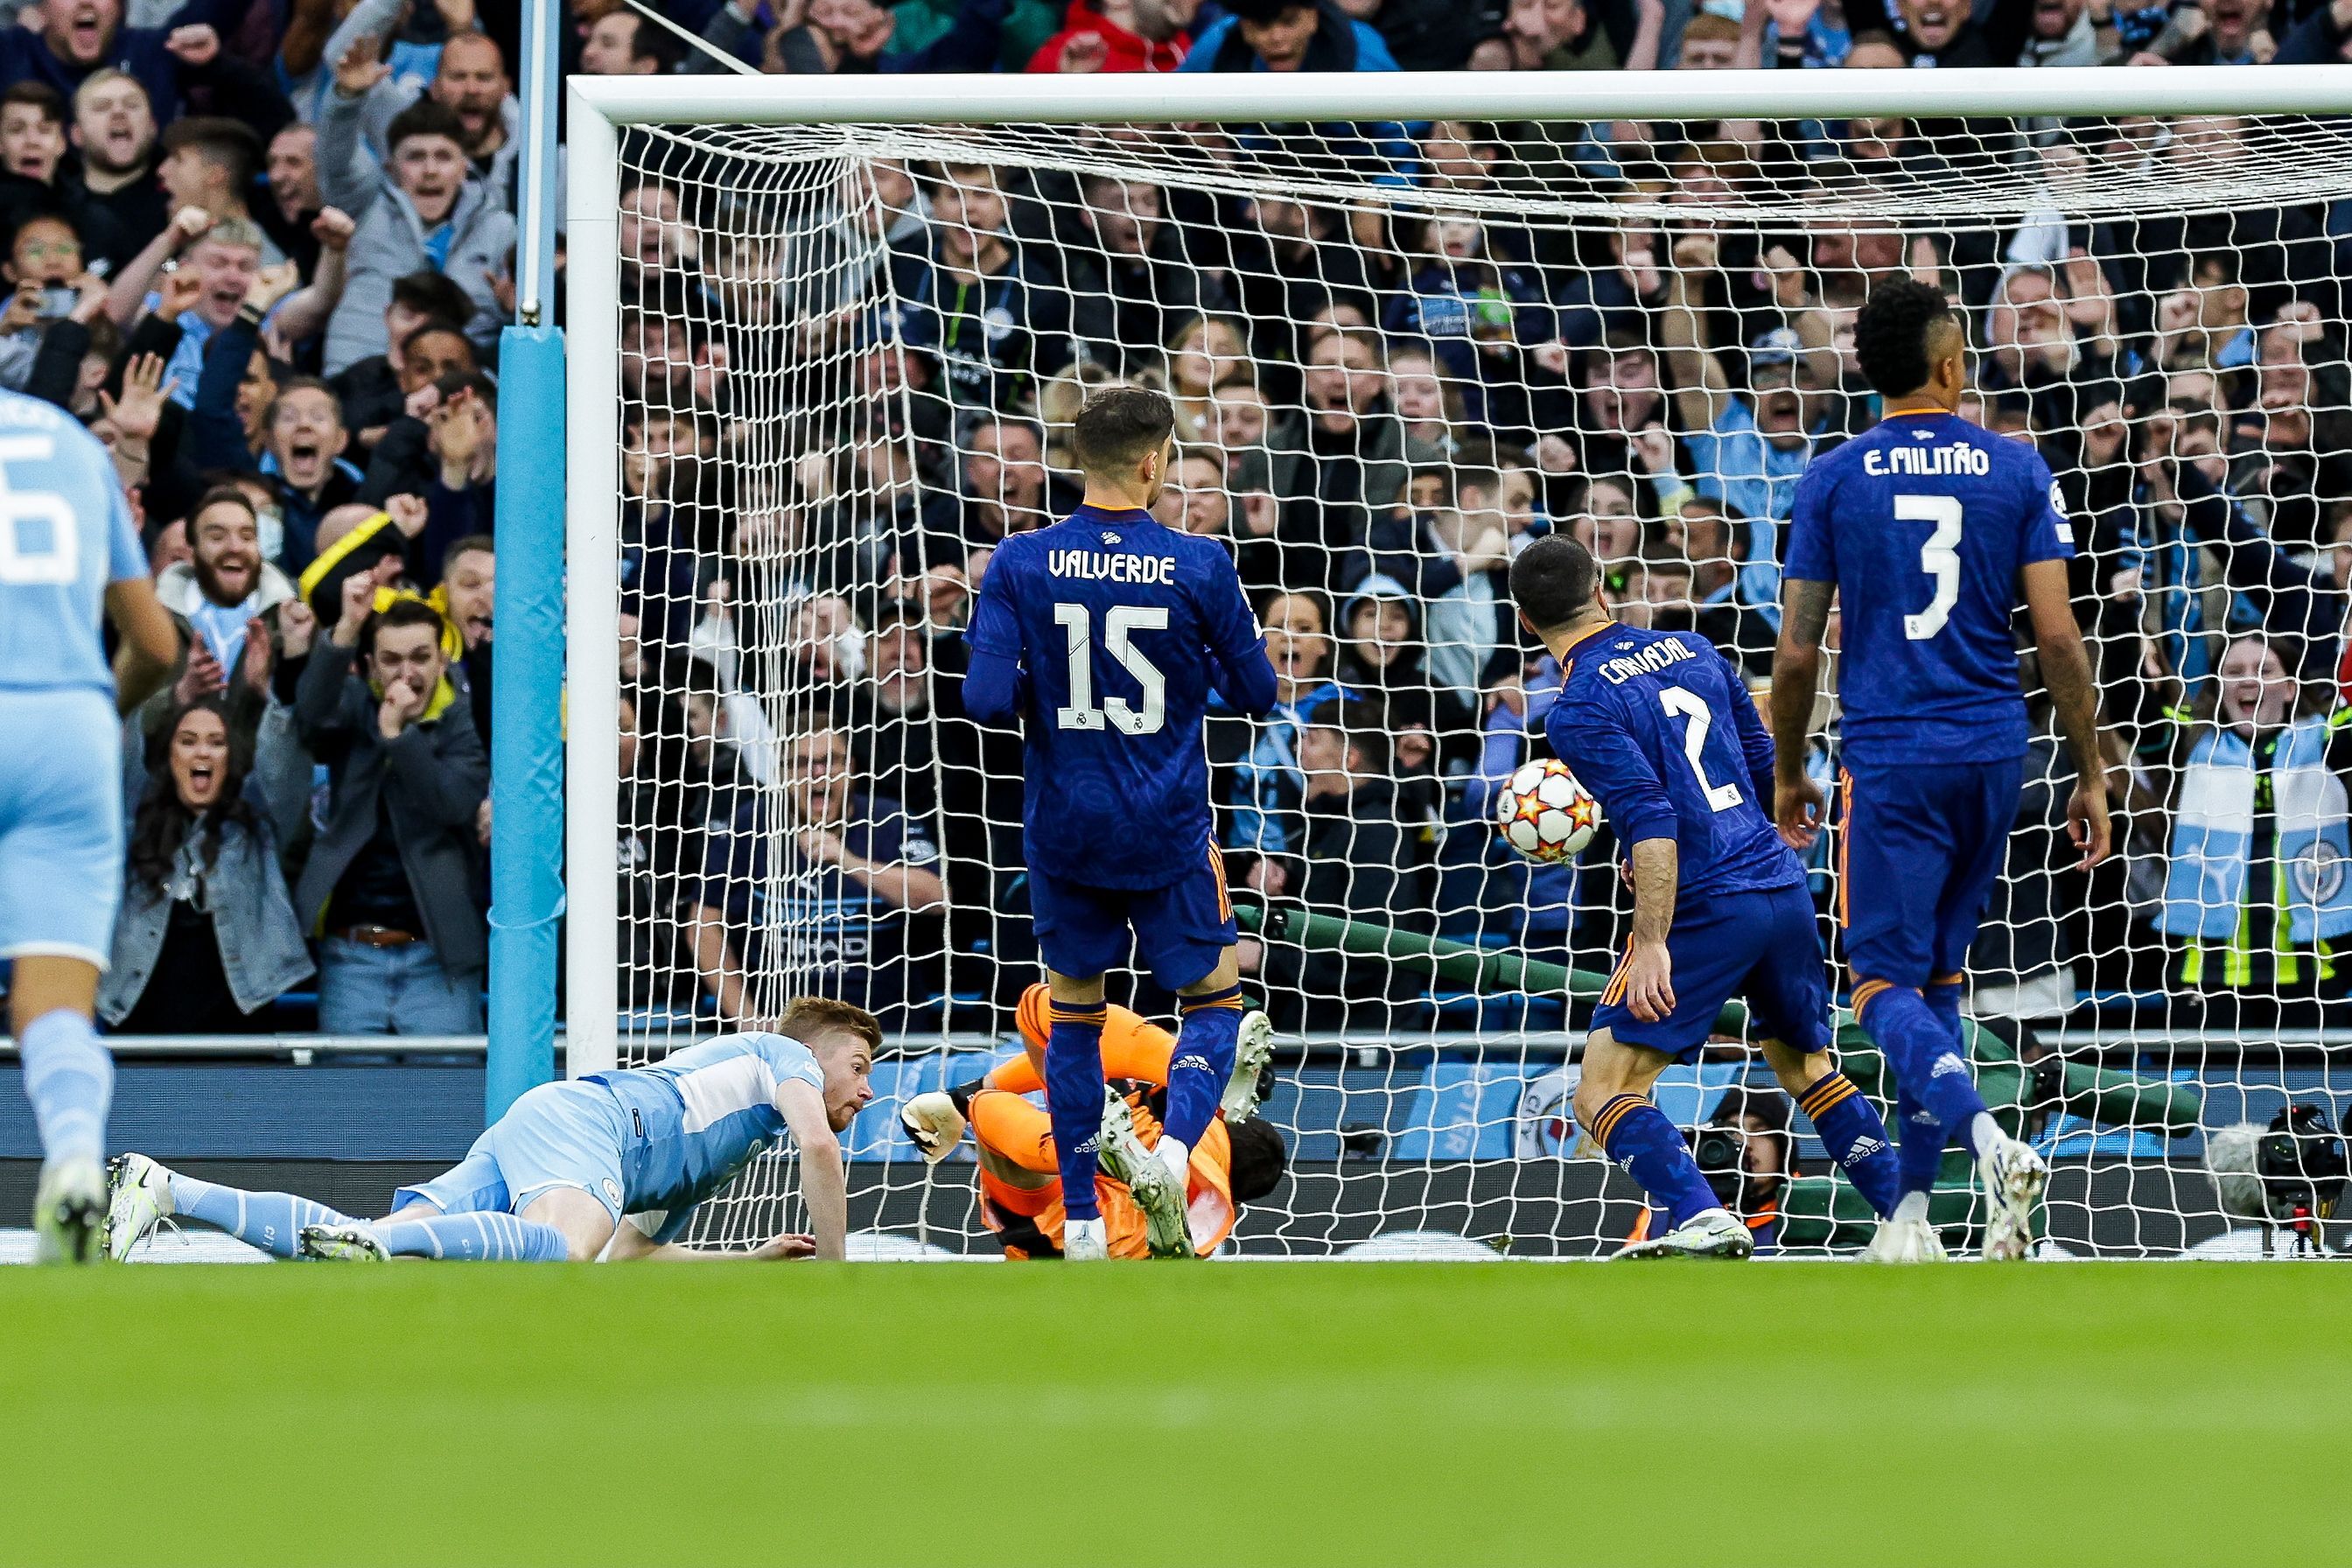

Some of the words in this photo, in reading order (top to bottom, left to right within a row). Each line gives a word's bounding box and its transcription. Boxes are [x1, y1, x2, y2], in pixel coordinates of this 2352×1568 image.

[1863, 442, 1990, 476] E.MILITÃO
[1048, 550, 1176, 585] VALVERDE
[1894, 494, 1964, 640] 3
[1054, 602, 1169, 735] 15
[1598, 636, 1698, 685] CARVAJAL
[1658, 685, 1744, 813] 2
[767, 936, 869, 958] TIHAD
[1171, 1060, 1214, 1075] adidas
[1843, 1139, 1886, 1168] adidas
